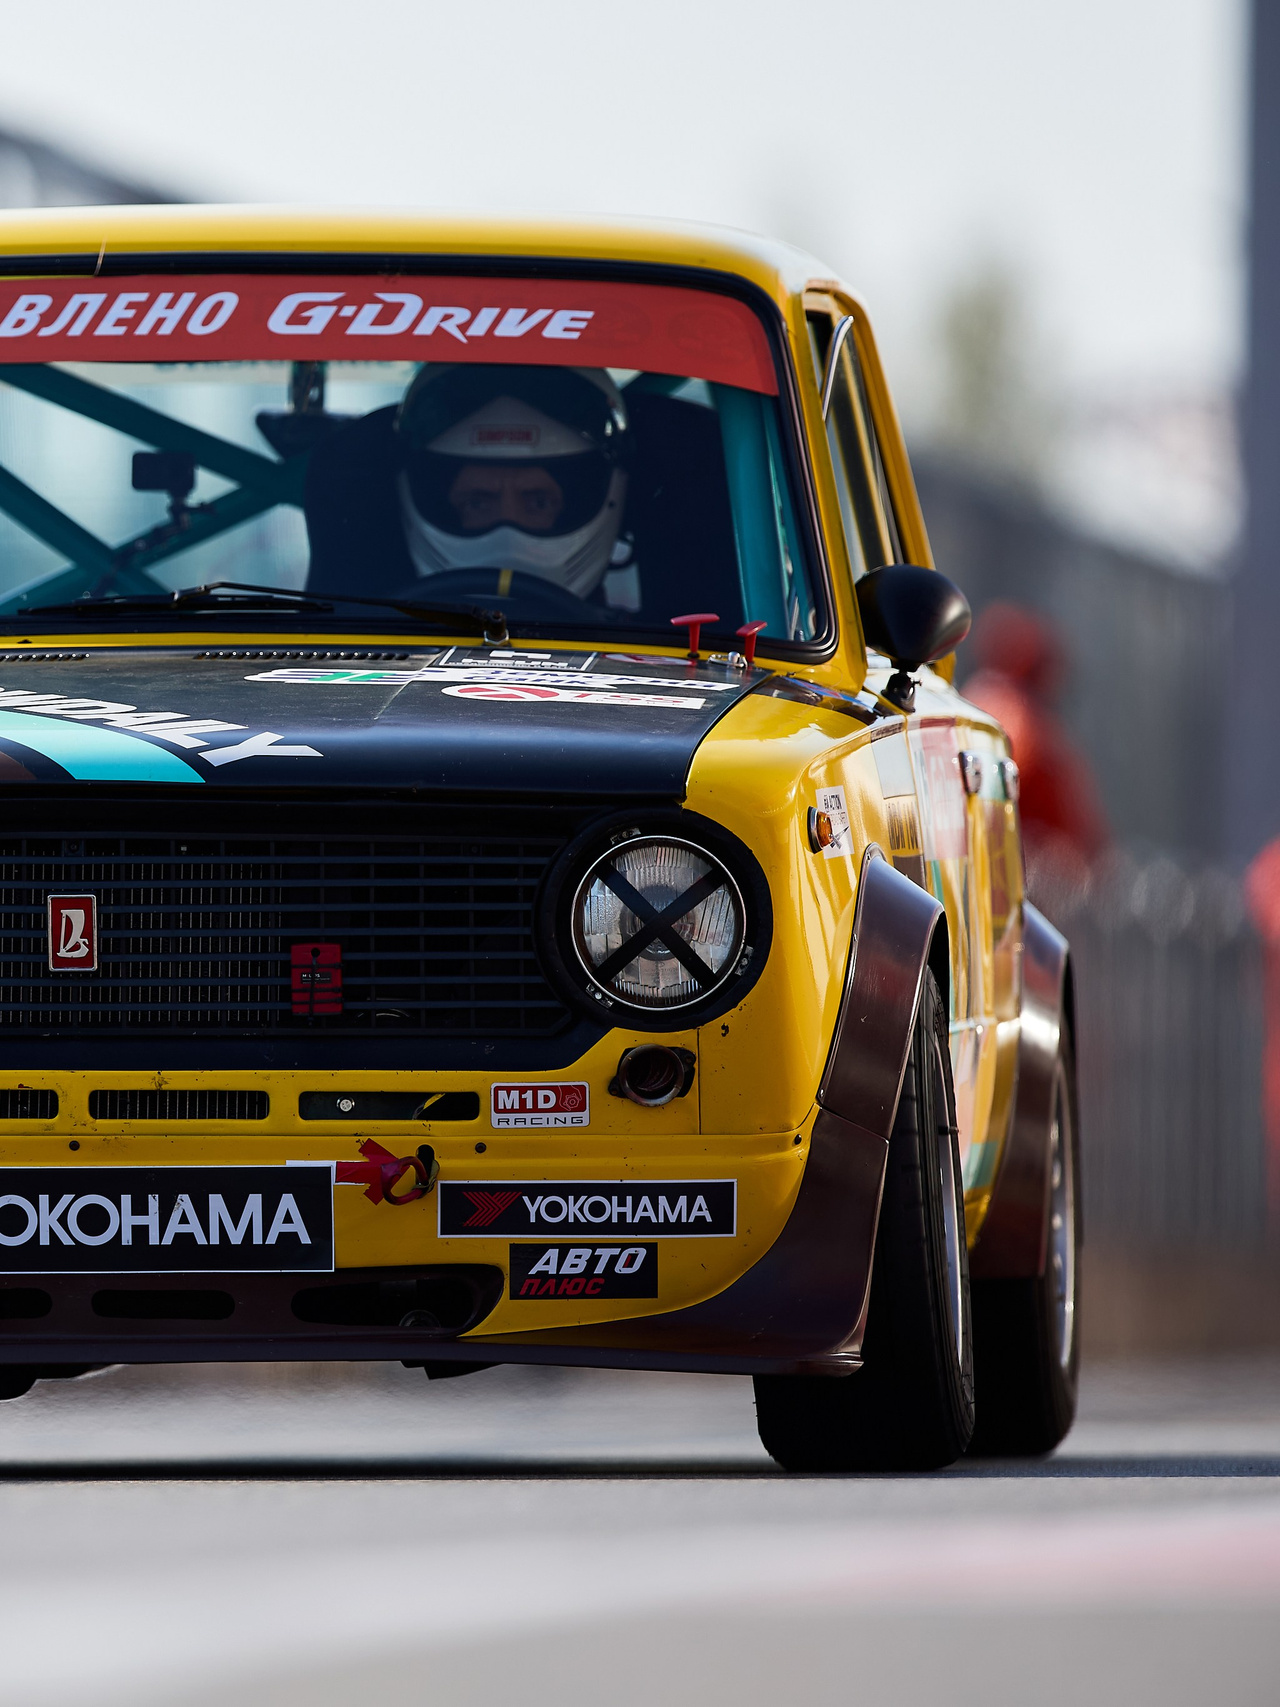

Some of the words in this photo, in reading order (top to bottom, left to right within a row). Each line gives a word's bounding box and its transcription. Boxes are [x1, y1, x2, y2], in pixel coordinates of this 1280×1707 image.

[497, 1089, 557, 1110] M1D
[497, 1115, 584, 1126] RACING
[521, 1195, 713, 1224] YOKOHAMA
[527, 1247, 648, 1275] АВТО
[519, 1277, 606, 1296] ПЛЮС
